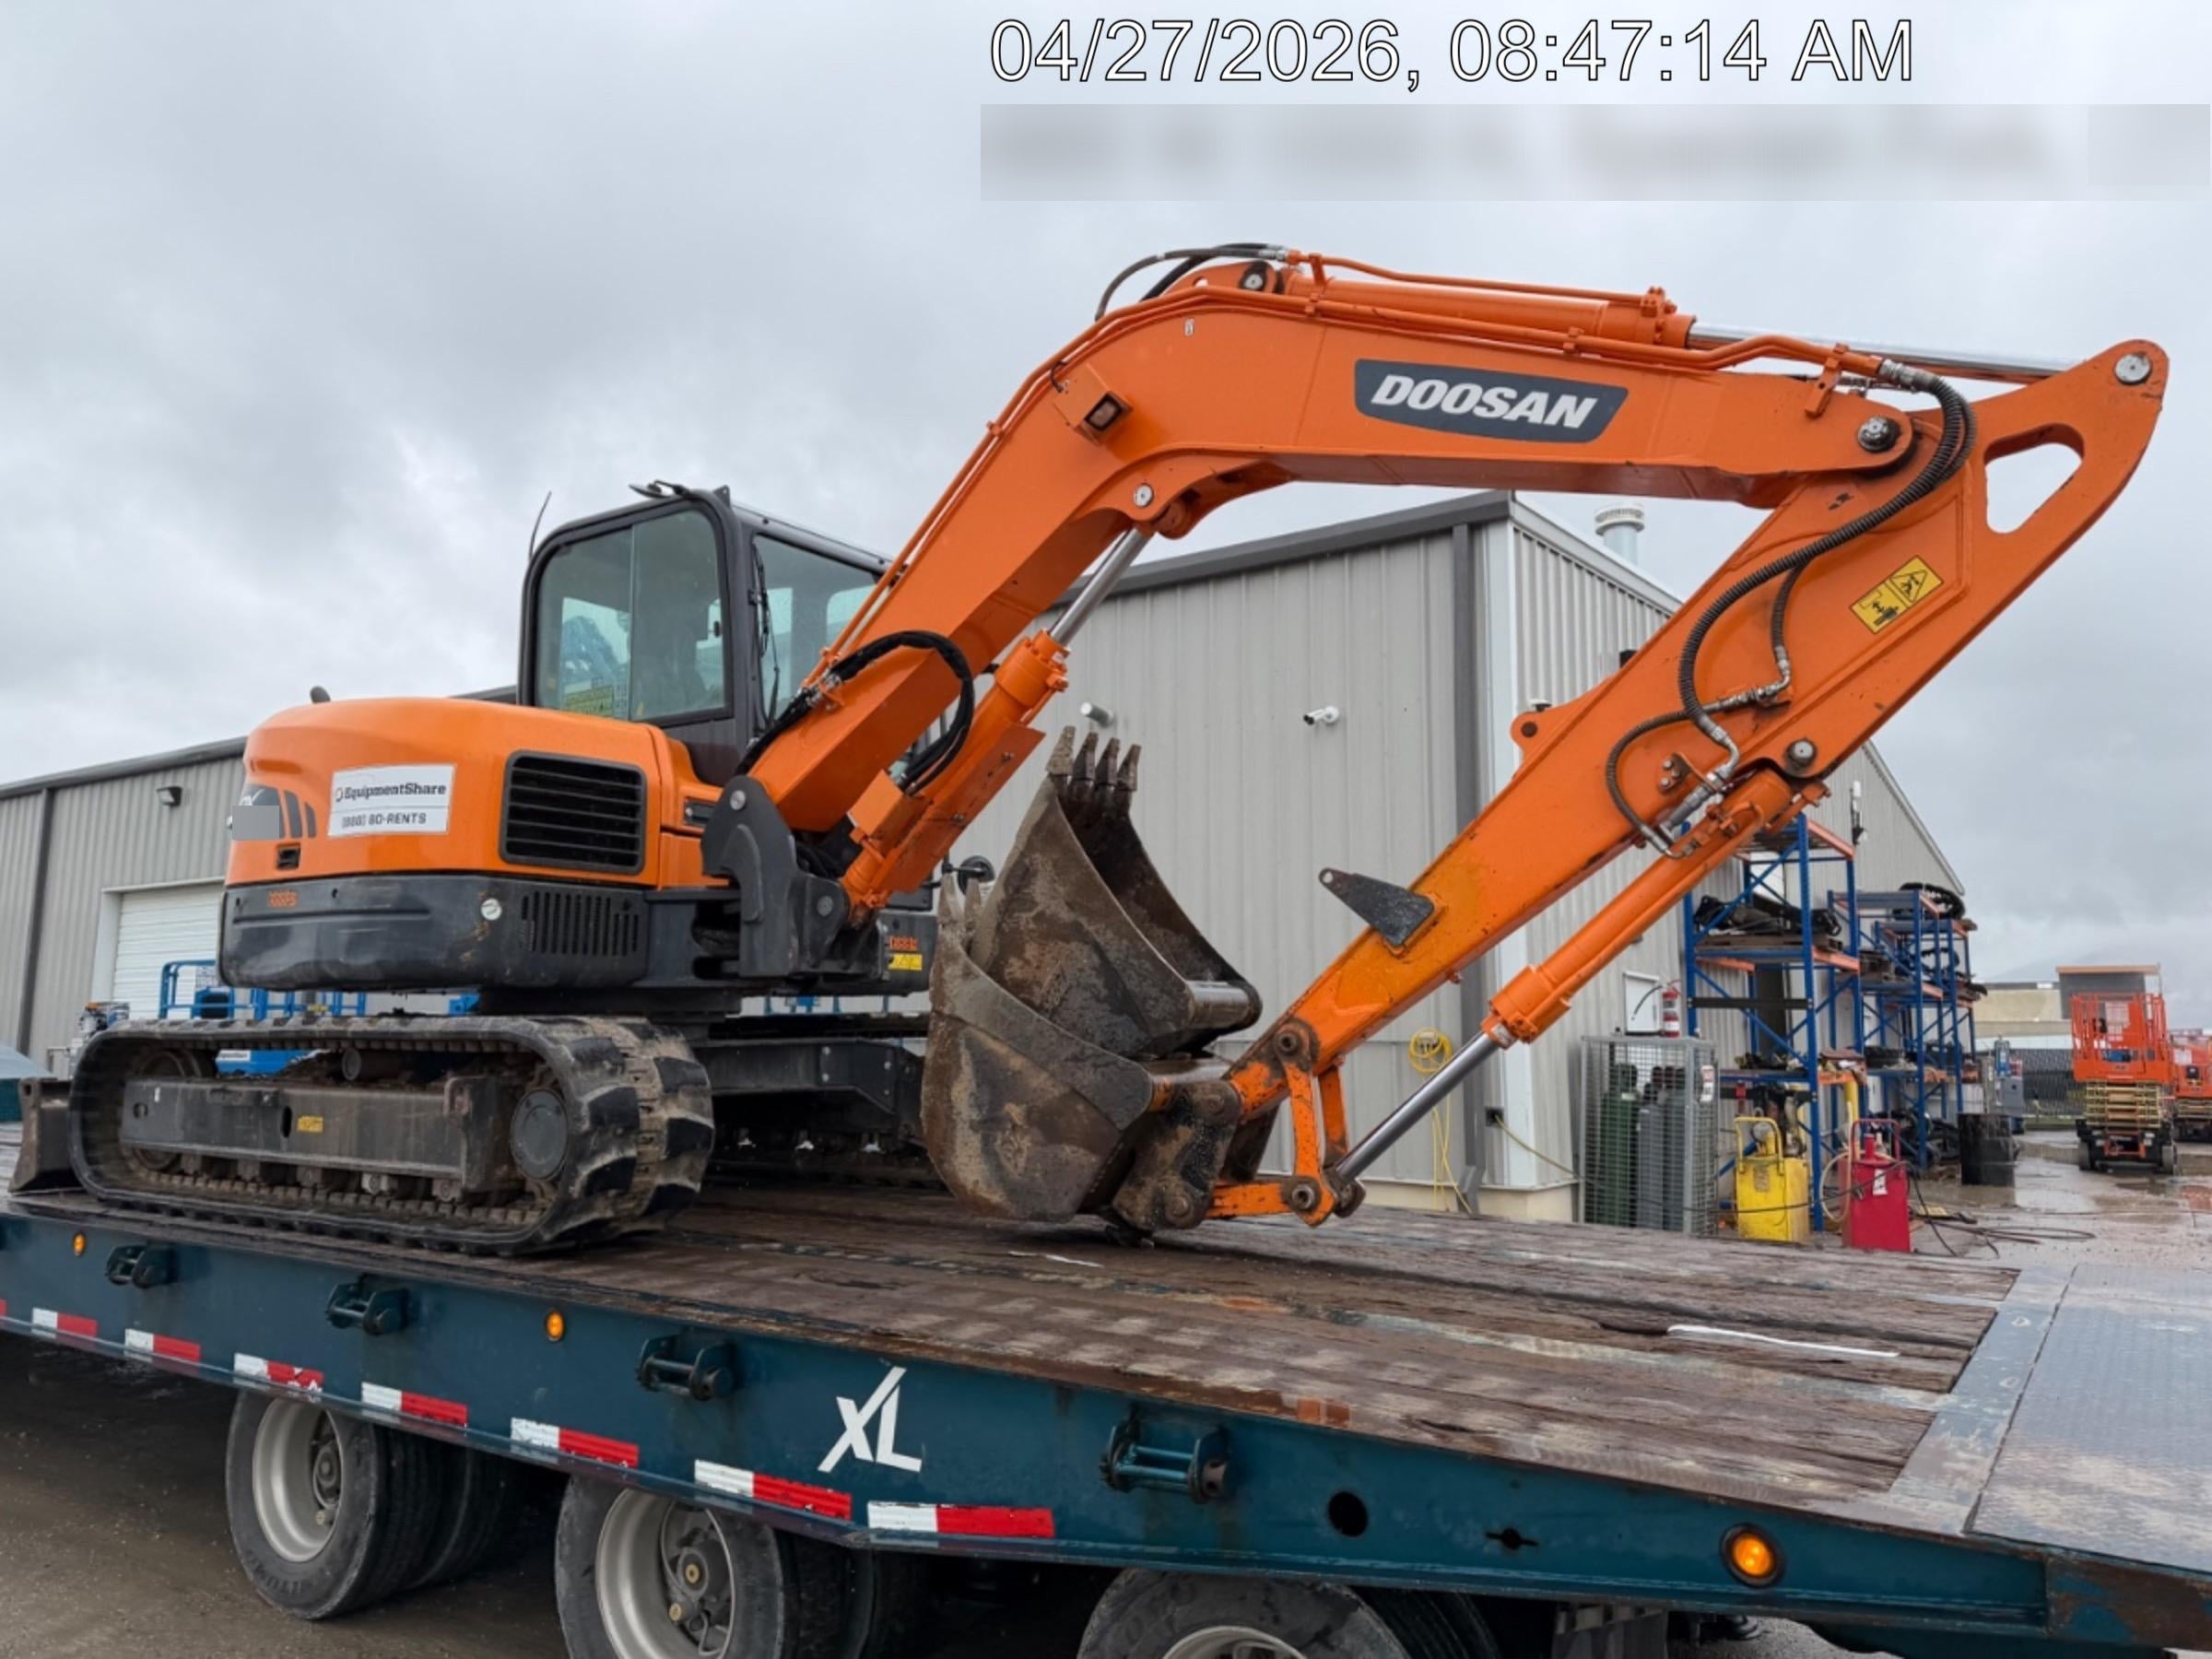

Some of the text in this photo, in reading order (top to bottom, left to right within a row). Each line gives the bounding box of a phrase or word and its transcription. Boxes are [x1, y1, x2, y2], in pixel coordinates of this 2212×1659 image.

[1371, 374, 1598, 429] DOOSAN
[344, 782, 447, 800] EquipmentShare
[817, 1365, 923, 1473] XL
